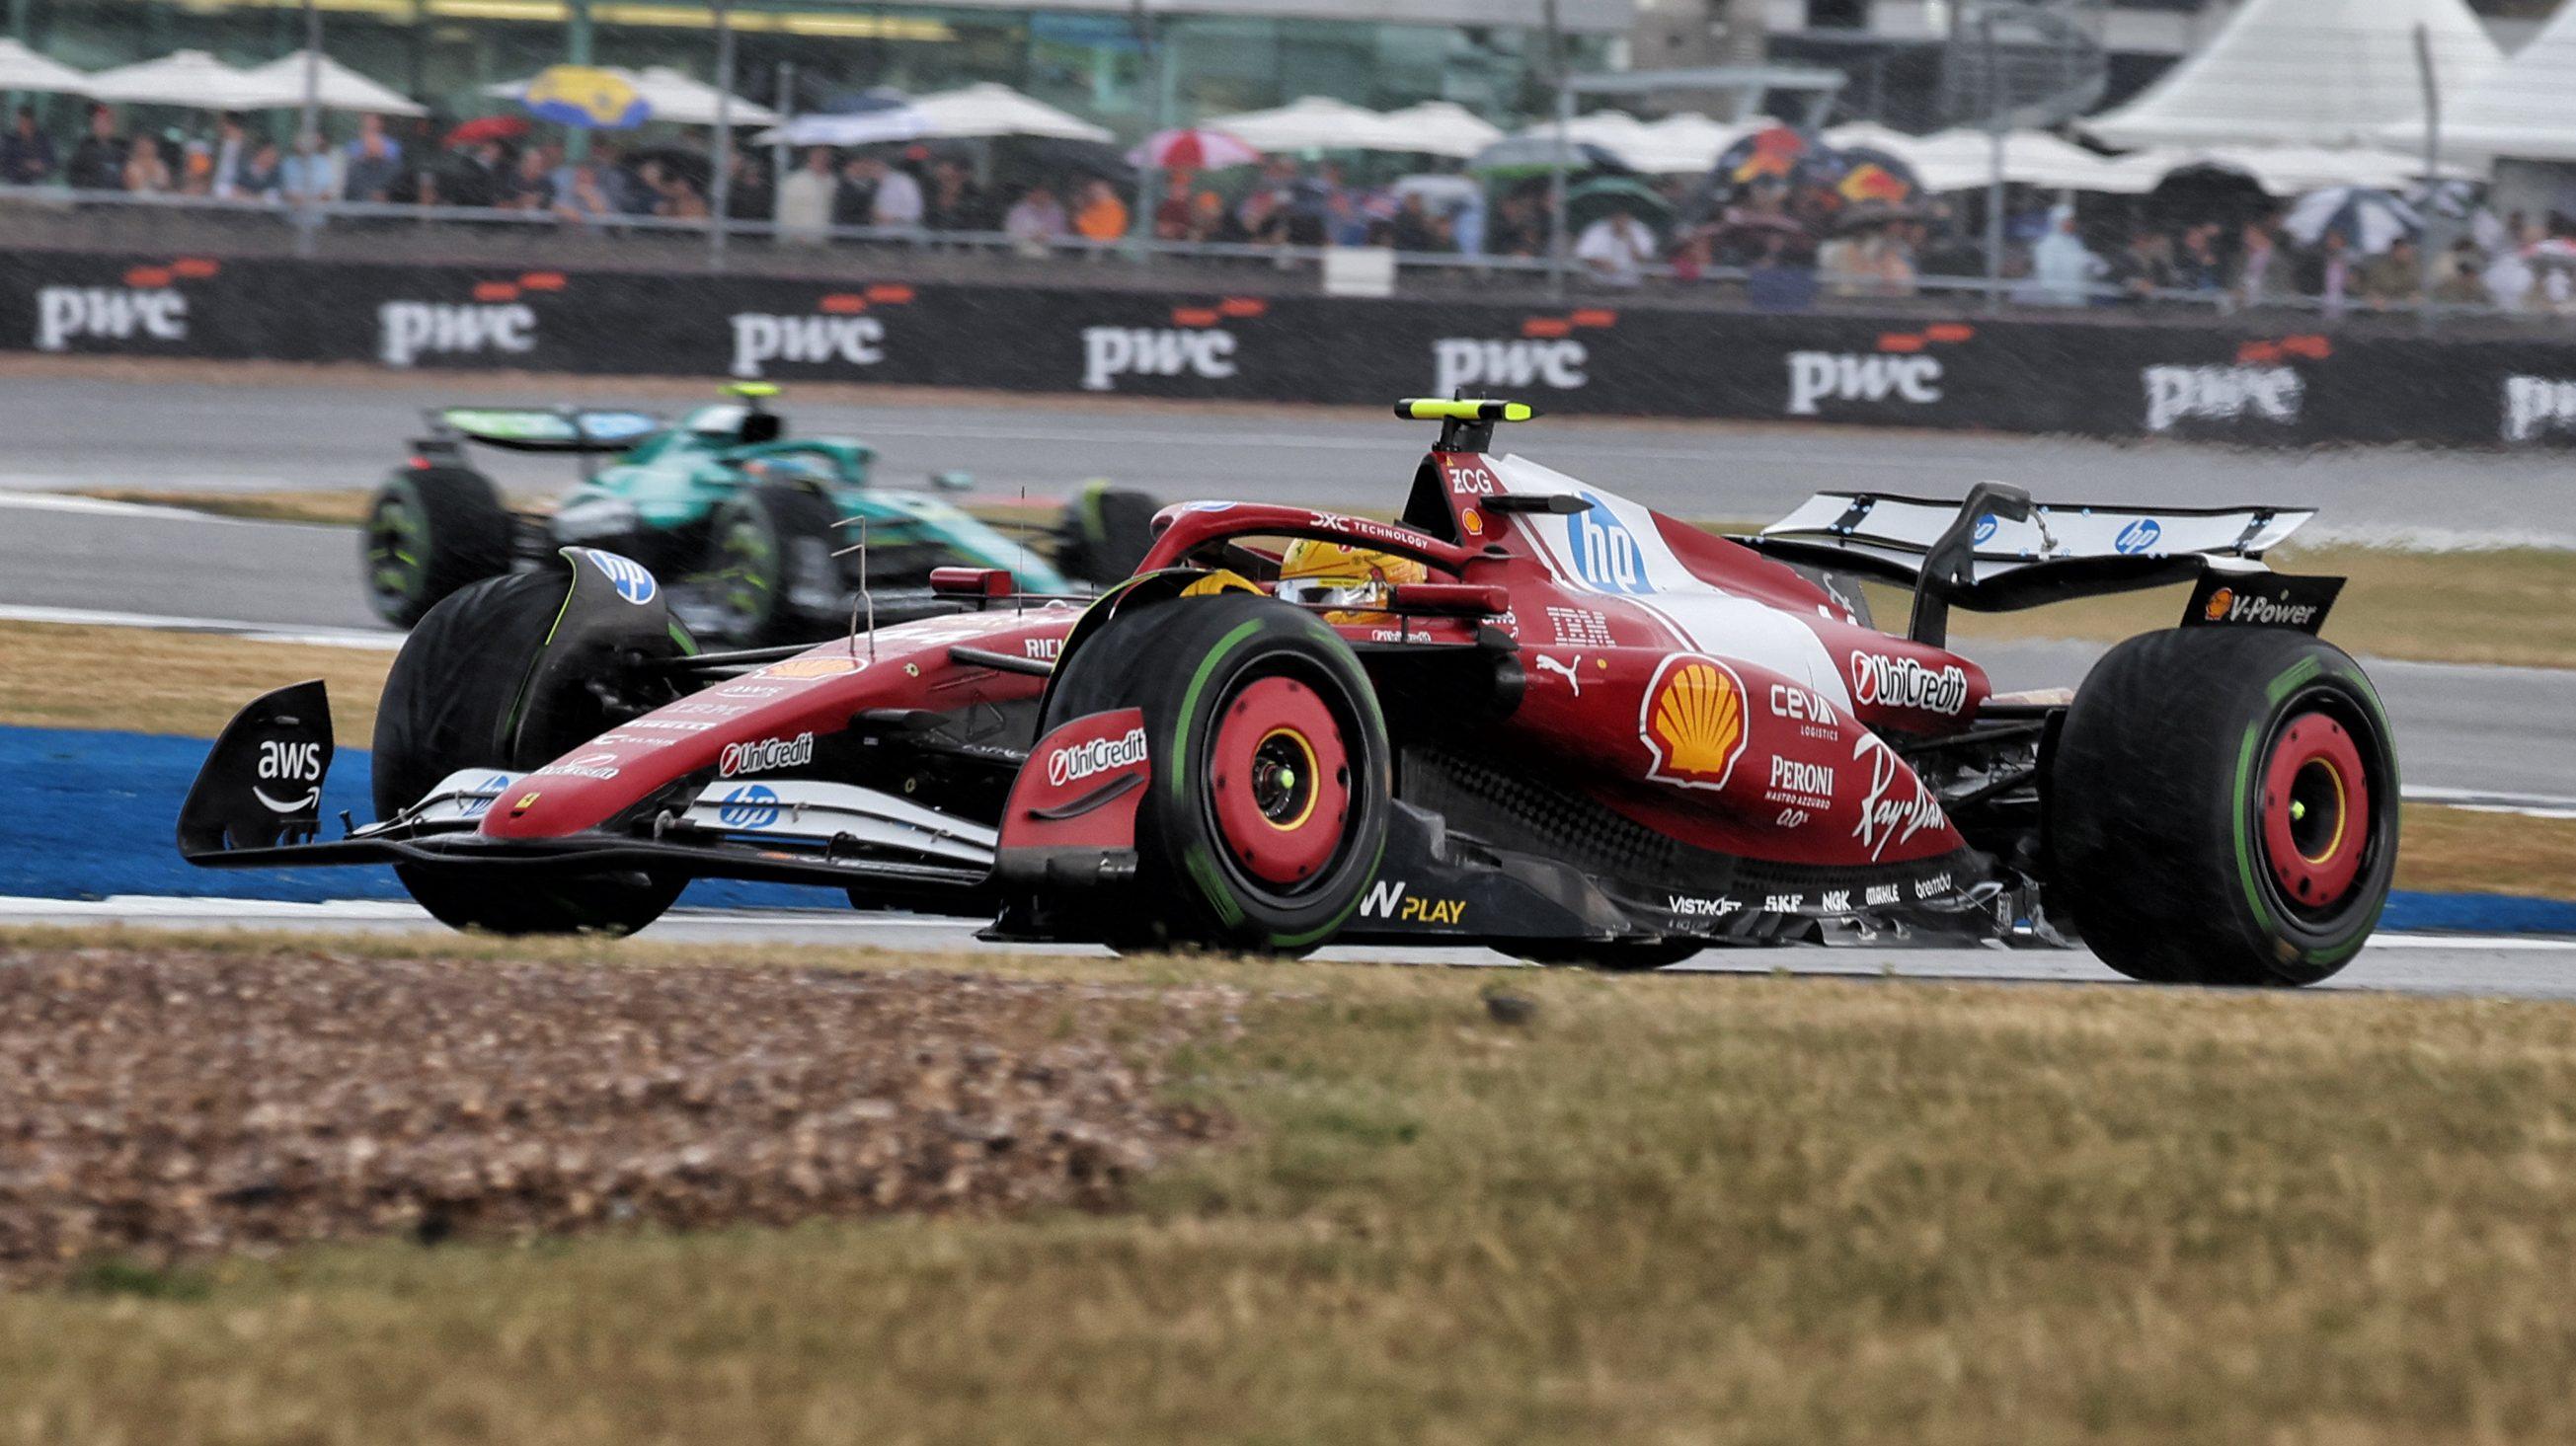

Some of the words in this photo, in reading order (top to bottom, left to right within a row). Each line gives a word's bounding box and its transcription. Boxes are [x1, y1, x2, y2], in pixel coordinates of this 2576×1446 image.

[37, 286, 189, 350] pwc
[379, 301, 537, 365] pwc
[731, 312, 885, 378] pwc
[1082, 326, 1238, 391] pwc
[1433, 338, 1588, 395] pwc
[1785, 350, 1943, 416] pwc
[1354, 521, 1429, 550] TECHNOLOGY
[1580, 494, 1638, 593] hp
[2118, 518, 2159, 555] hp
[596, 551, 646, 601] hp
[1546, 606, 1617, 647] IBM
[2229, 594, 2317, 625] V-Power
[1873, 654, 1968, 716] UniCredit
[739, 731, 815, 776] UniCredit
[1066, 727, 1148, 780] UniCredit
[1800, 723, 1839, 742] LOGISTICS
[257, 740, 321, 782] aws
[1769, 754, 1834, 798] PERONI
[724, 784, 777, 830] hp
[1764, 791, 1797, 804] NASTRO
[1401, 896, 1467, 925] PLAY
[1763, 893, 1804, 913] SKF
[1822, 889, 1852, 912] NGK
[1915, 872, 1951, 900] brembo
